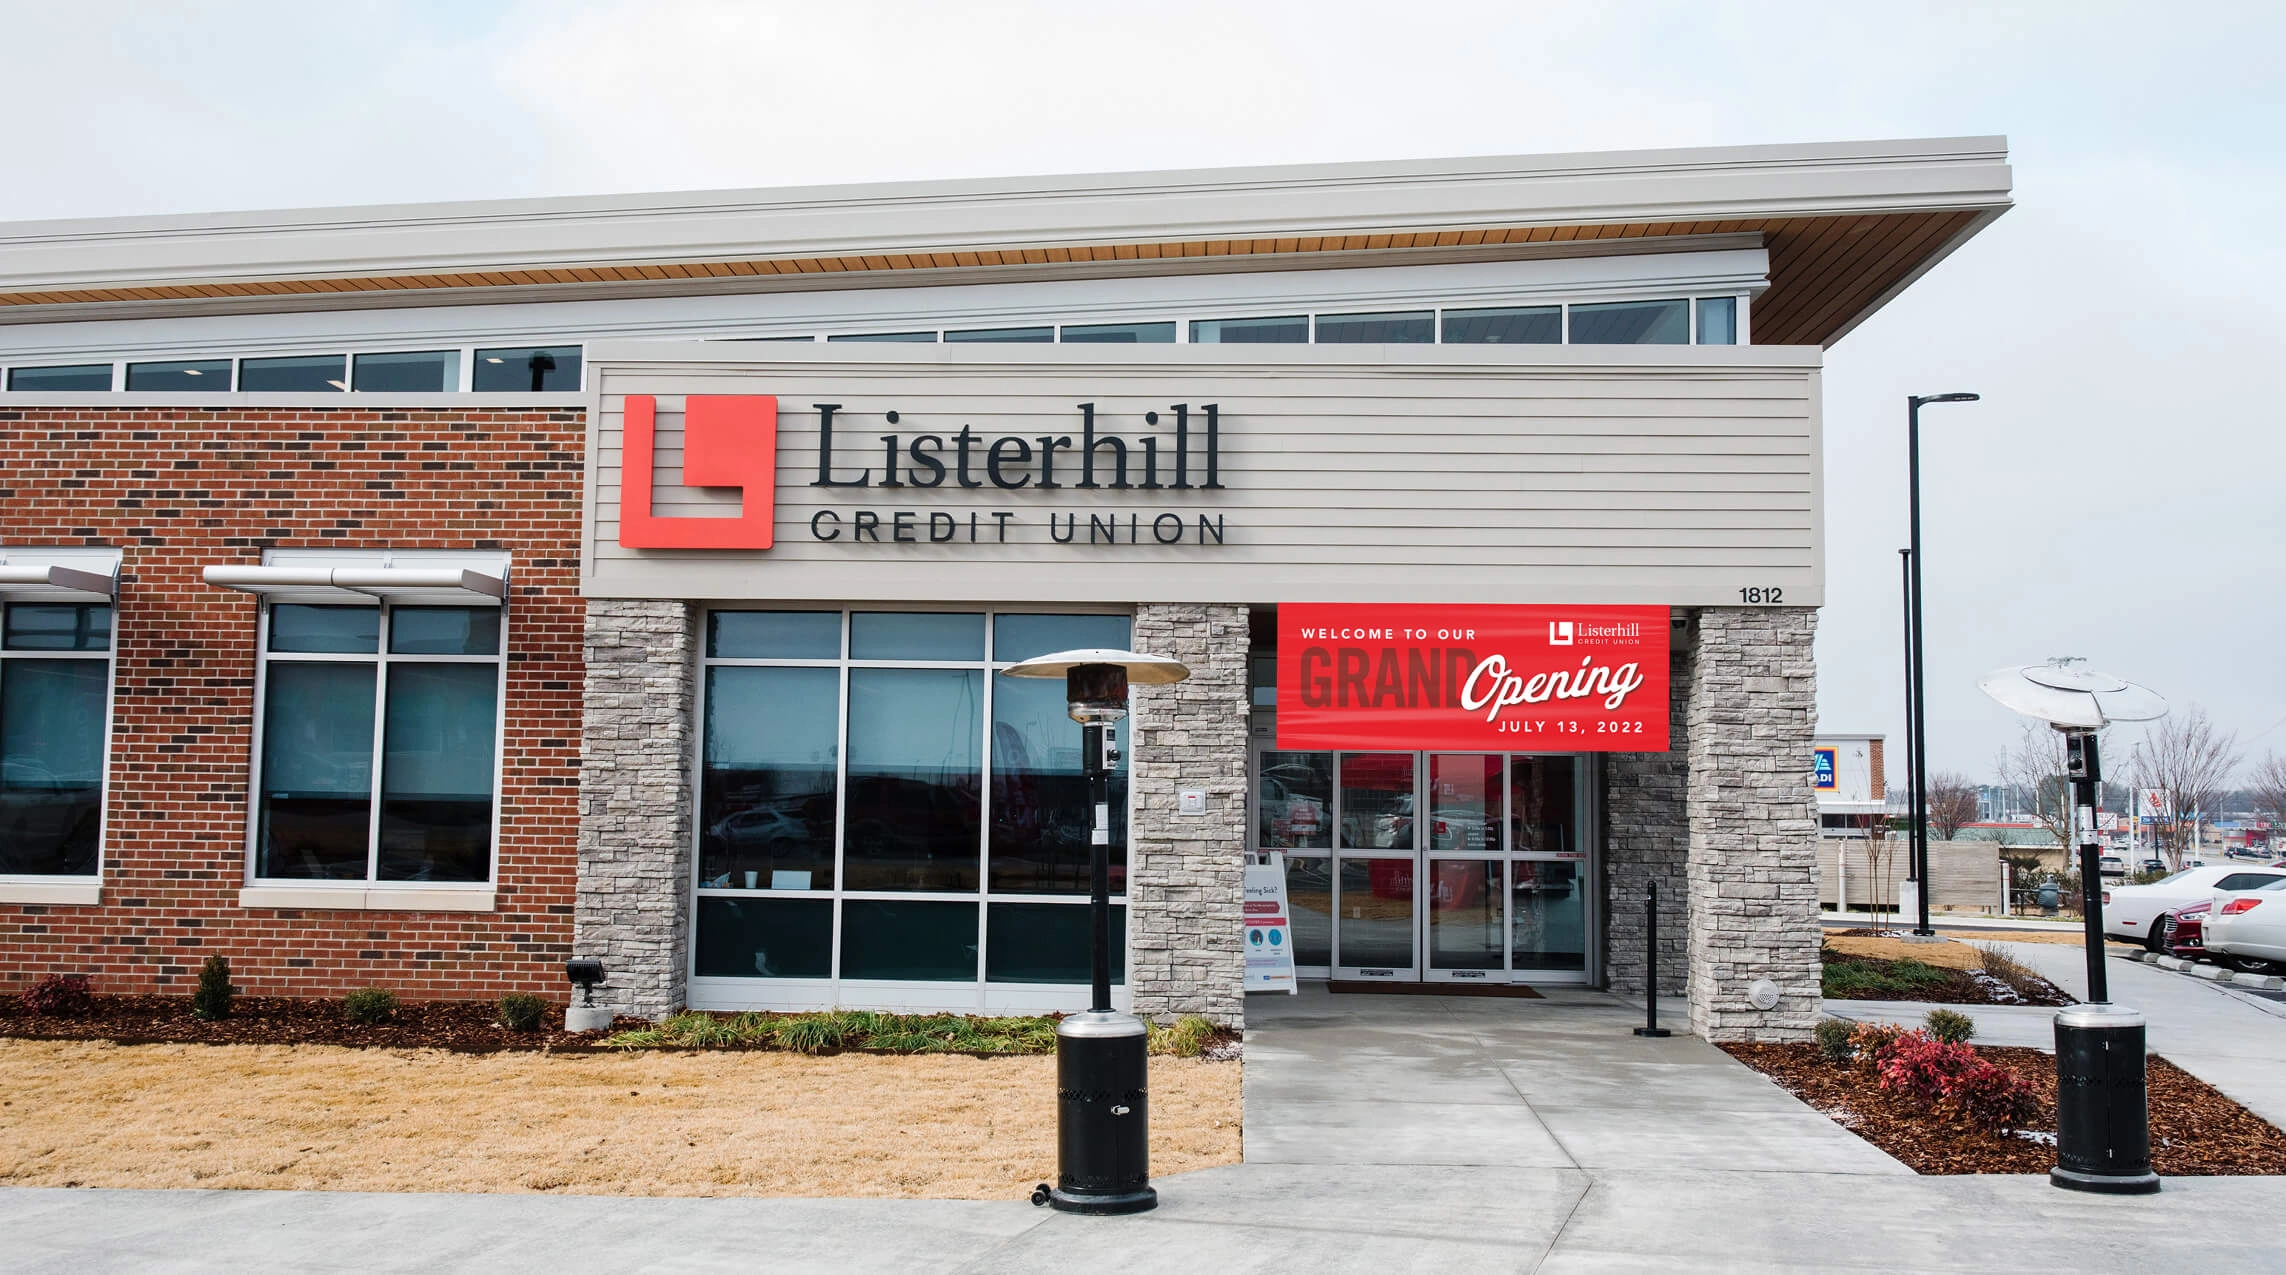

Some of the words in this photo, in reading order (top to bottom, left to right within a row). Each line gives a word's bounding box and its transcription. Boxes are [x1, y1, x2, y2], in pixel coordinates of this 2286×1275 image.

[809, 402, 1225, 490] Listerhill
[811, 509, 1013, 543] CREDIT
[1050, 512, 1224, 545] UNION
[1738, 587, 1783, 603] 1812
[1301, 628, 1393, 640] WELCOME
[1404, 628, 1427, 640] TO
[1438, 628, 1475, 640] OUR
[1578, 622, 1640, 637] Listerhill
[1300, 646, 1477, 709] GRAND
[1461, 654, 1644, 722] Opening
[1498, 720, 1546, 733] JULY
[1557, 720, 1586, 735] 13,
[1597, 721, 1643, 733] 2022
[1244, 886, 1263, 896] eeling
